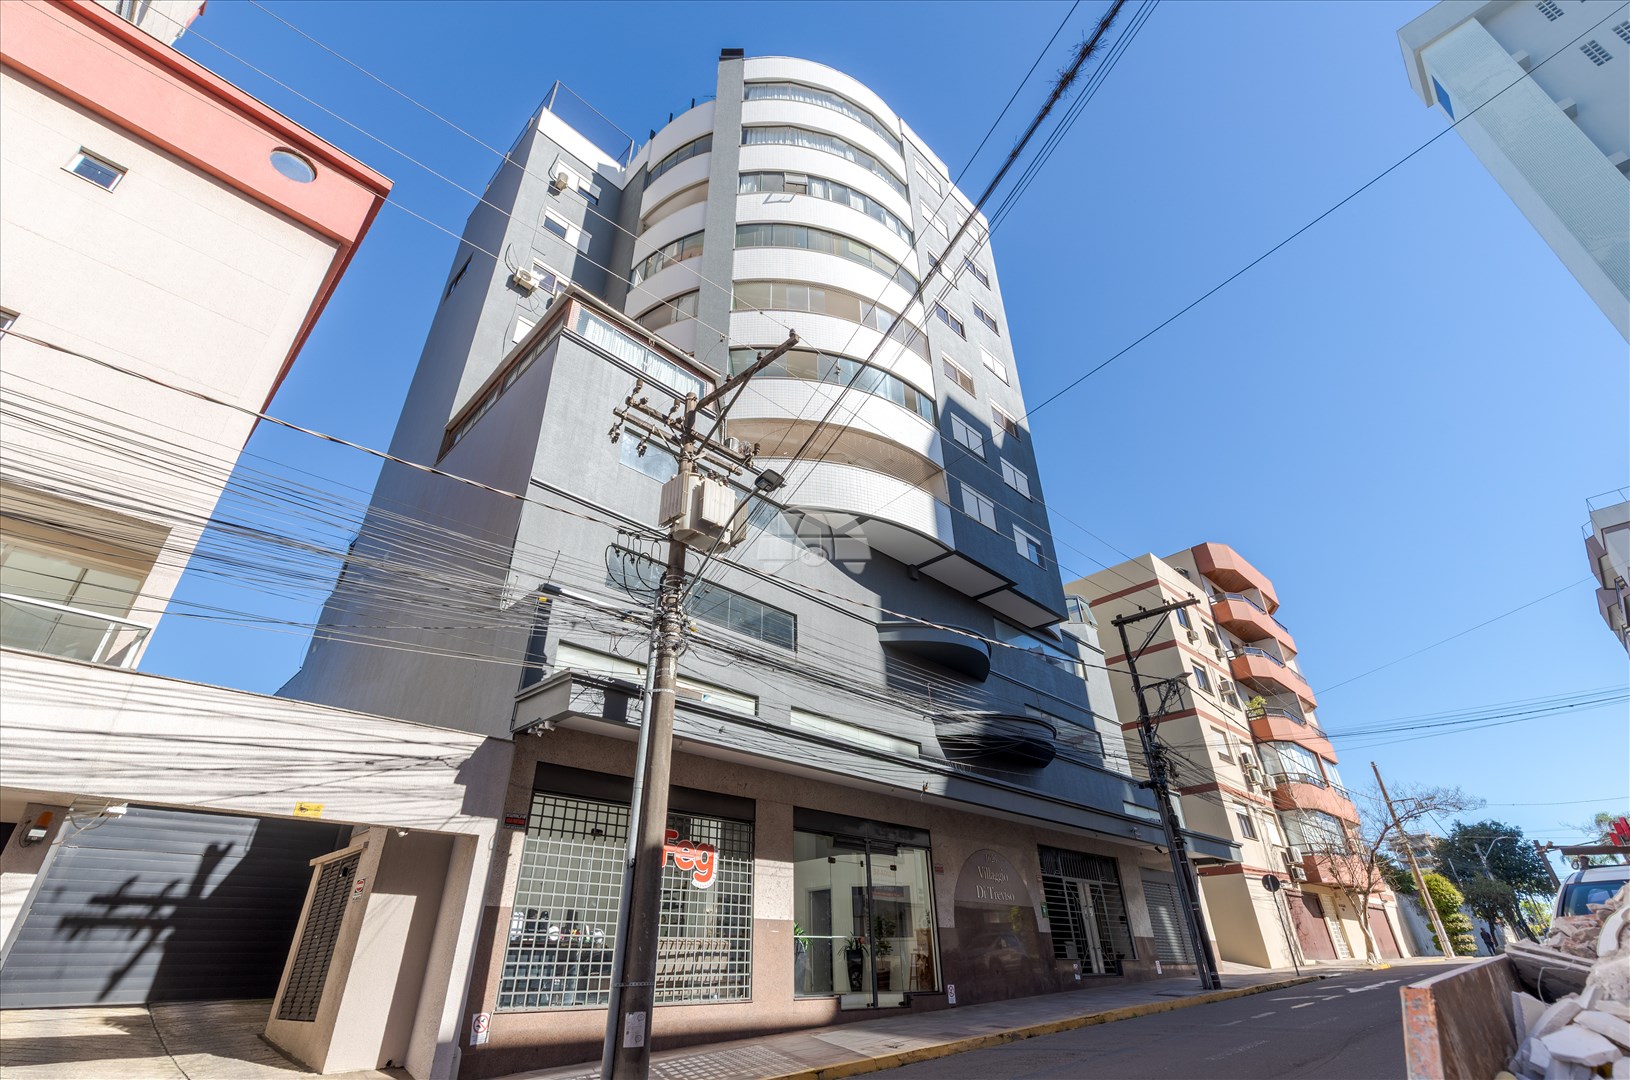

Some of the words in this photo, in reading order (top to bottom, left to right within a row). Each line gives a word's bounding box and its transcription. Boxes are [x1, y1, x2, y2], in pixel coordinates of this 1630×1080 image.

[977, 865, 1009, 884] Villaggio
[976, 885, 987, 899] Di
[987, 886, 1015, 901] Treviso
